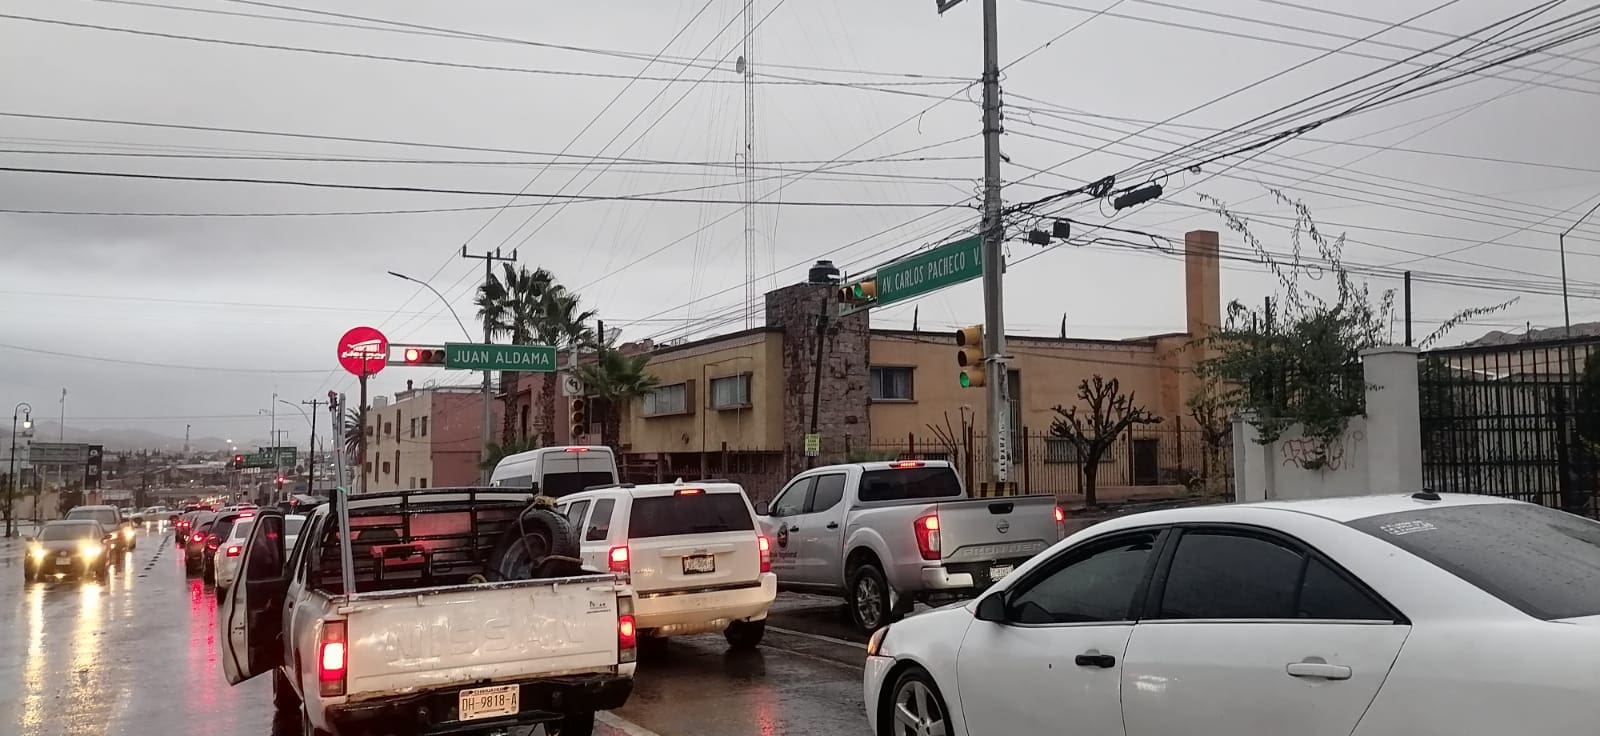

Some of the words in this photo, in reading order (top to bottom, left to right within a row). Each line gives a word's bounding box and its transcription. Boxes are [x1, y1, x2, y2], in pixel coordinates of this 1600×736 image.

[882, 277, 893, 295] AV.
[895, 266, 924, 291] CARLOS
[928, 251, 965, 278] PACHECO
[454, 349, 489, 364] JUAN
[495, 351, 549, 366] ALDAMA
[462, 692, 517, 711] DH-9818-A
